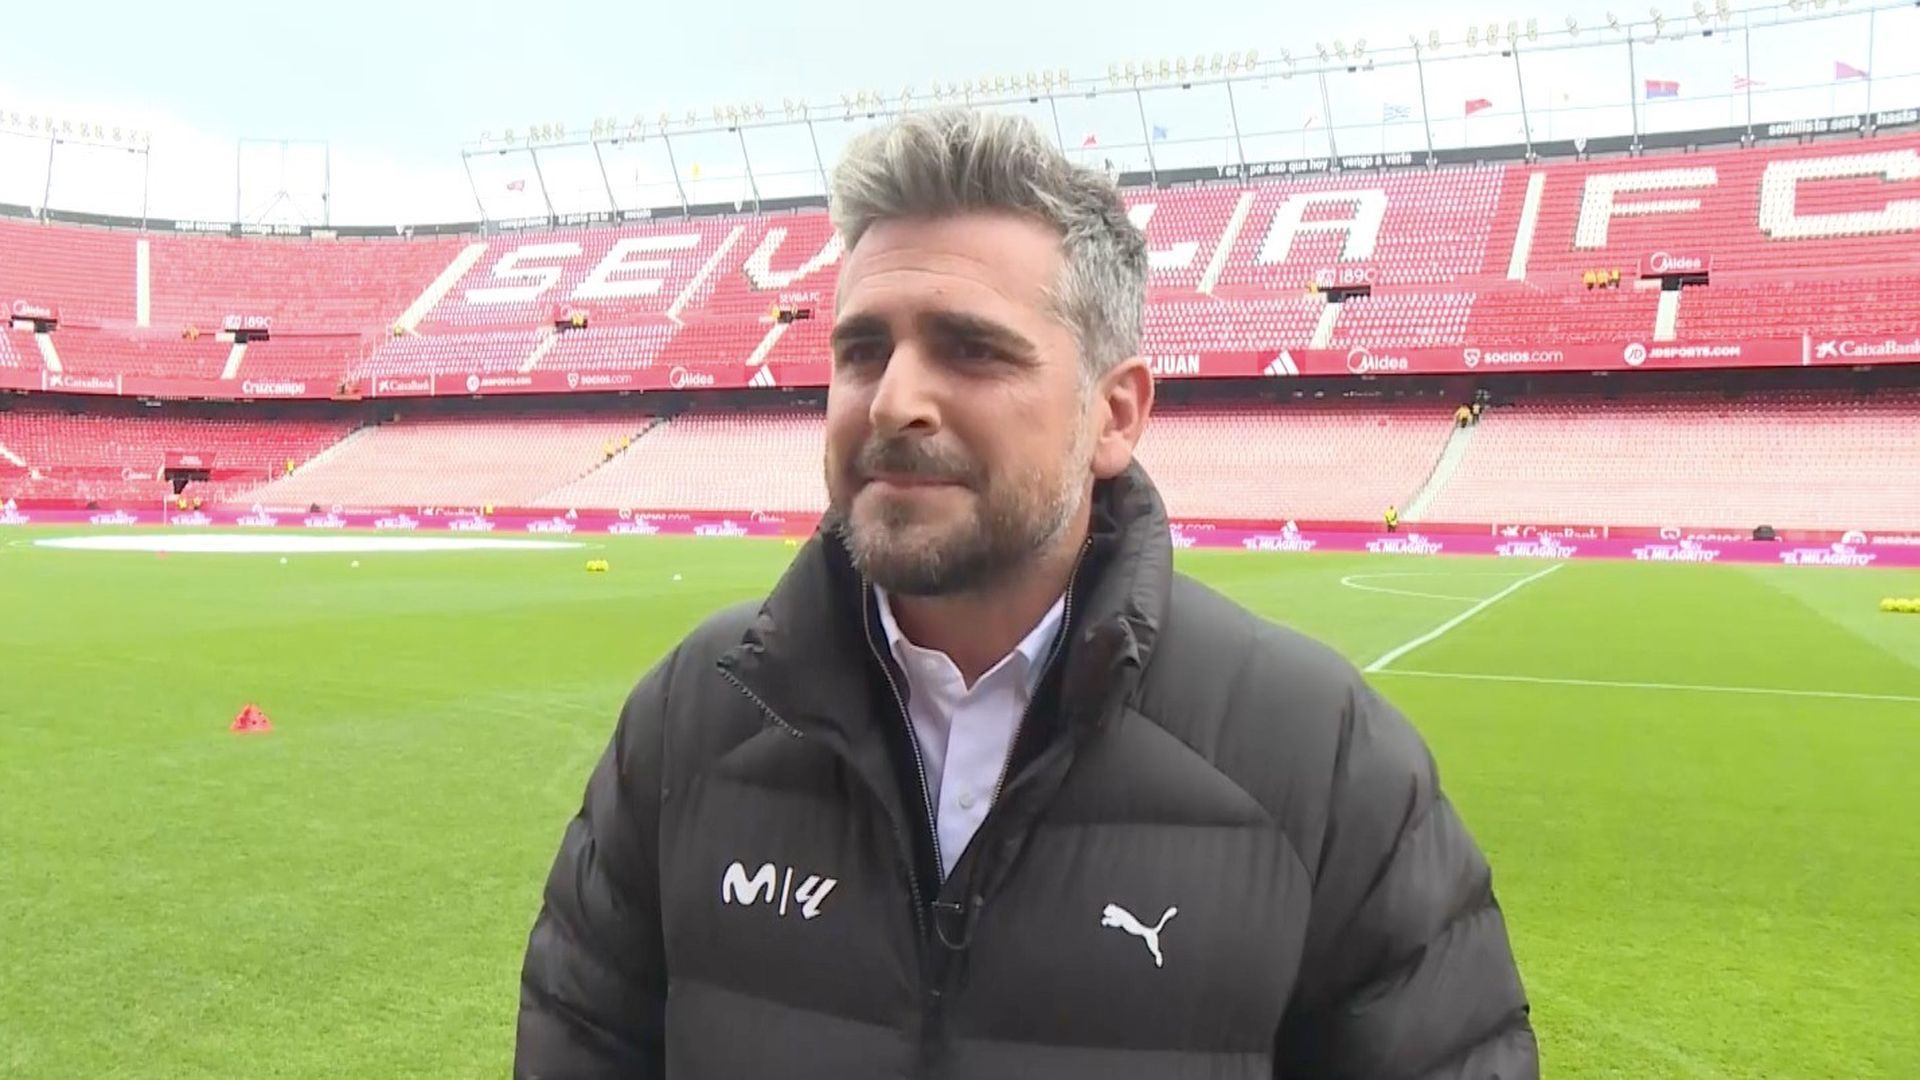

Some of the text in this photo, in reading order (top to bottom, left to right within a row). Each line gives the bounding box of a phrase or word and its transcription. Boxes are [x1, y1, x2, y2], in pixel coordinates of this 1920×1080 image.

[1877, 110, 1918, 125] hasta
[1249, 164, 1267, 176] por
[1268, 162, 1286, 173] eso
[1289, 161, 1308, 174] que
[1309, 157, 1329, 171] hoy
[1342, 157, 1373, 169] vengo
[1385, 152, 1412, 165] verte
[1574, 149, 1920, 248] FC
[1654, 253, 1701, 271] Midea
[1153, 354, 1200, 375] JUAN
[1352, 352, 1409, 372] Midea
[242, 380, 305, 396] Cruzcampo
[672, 368, 714, 388] Midea
